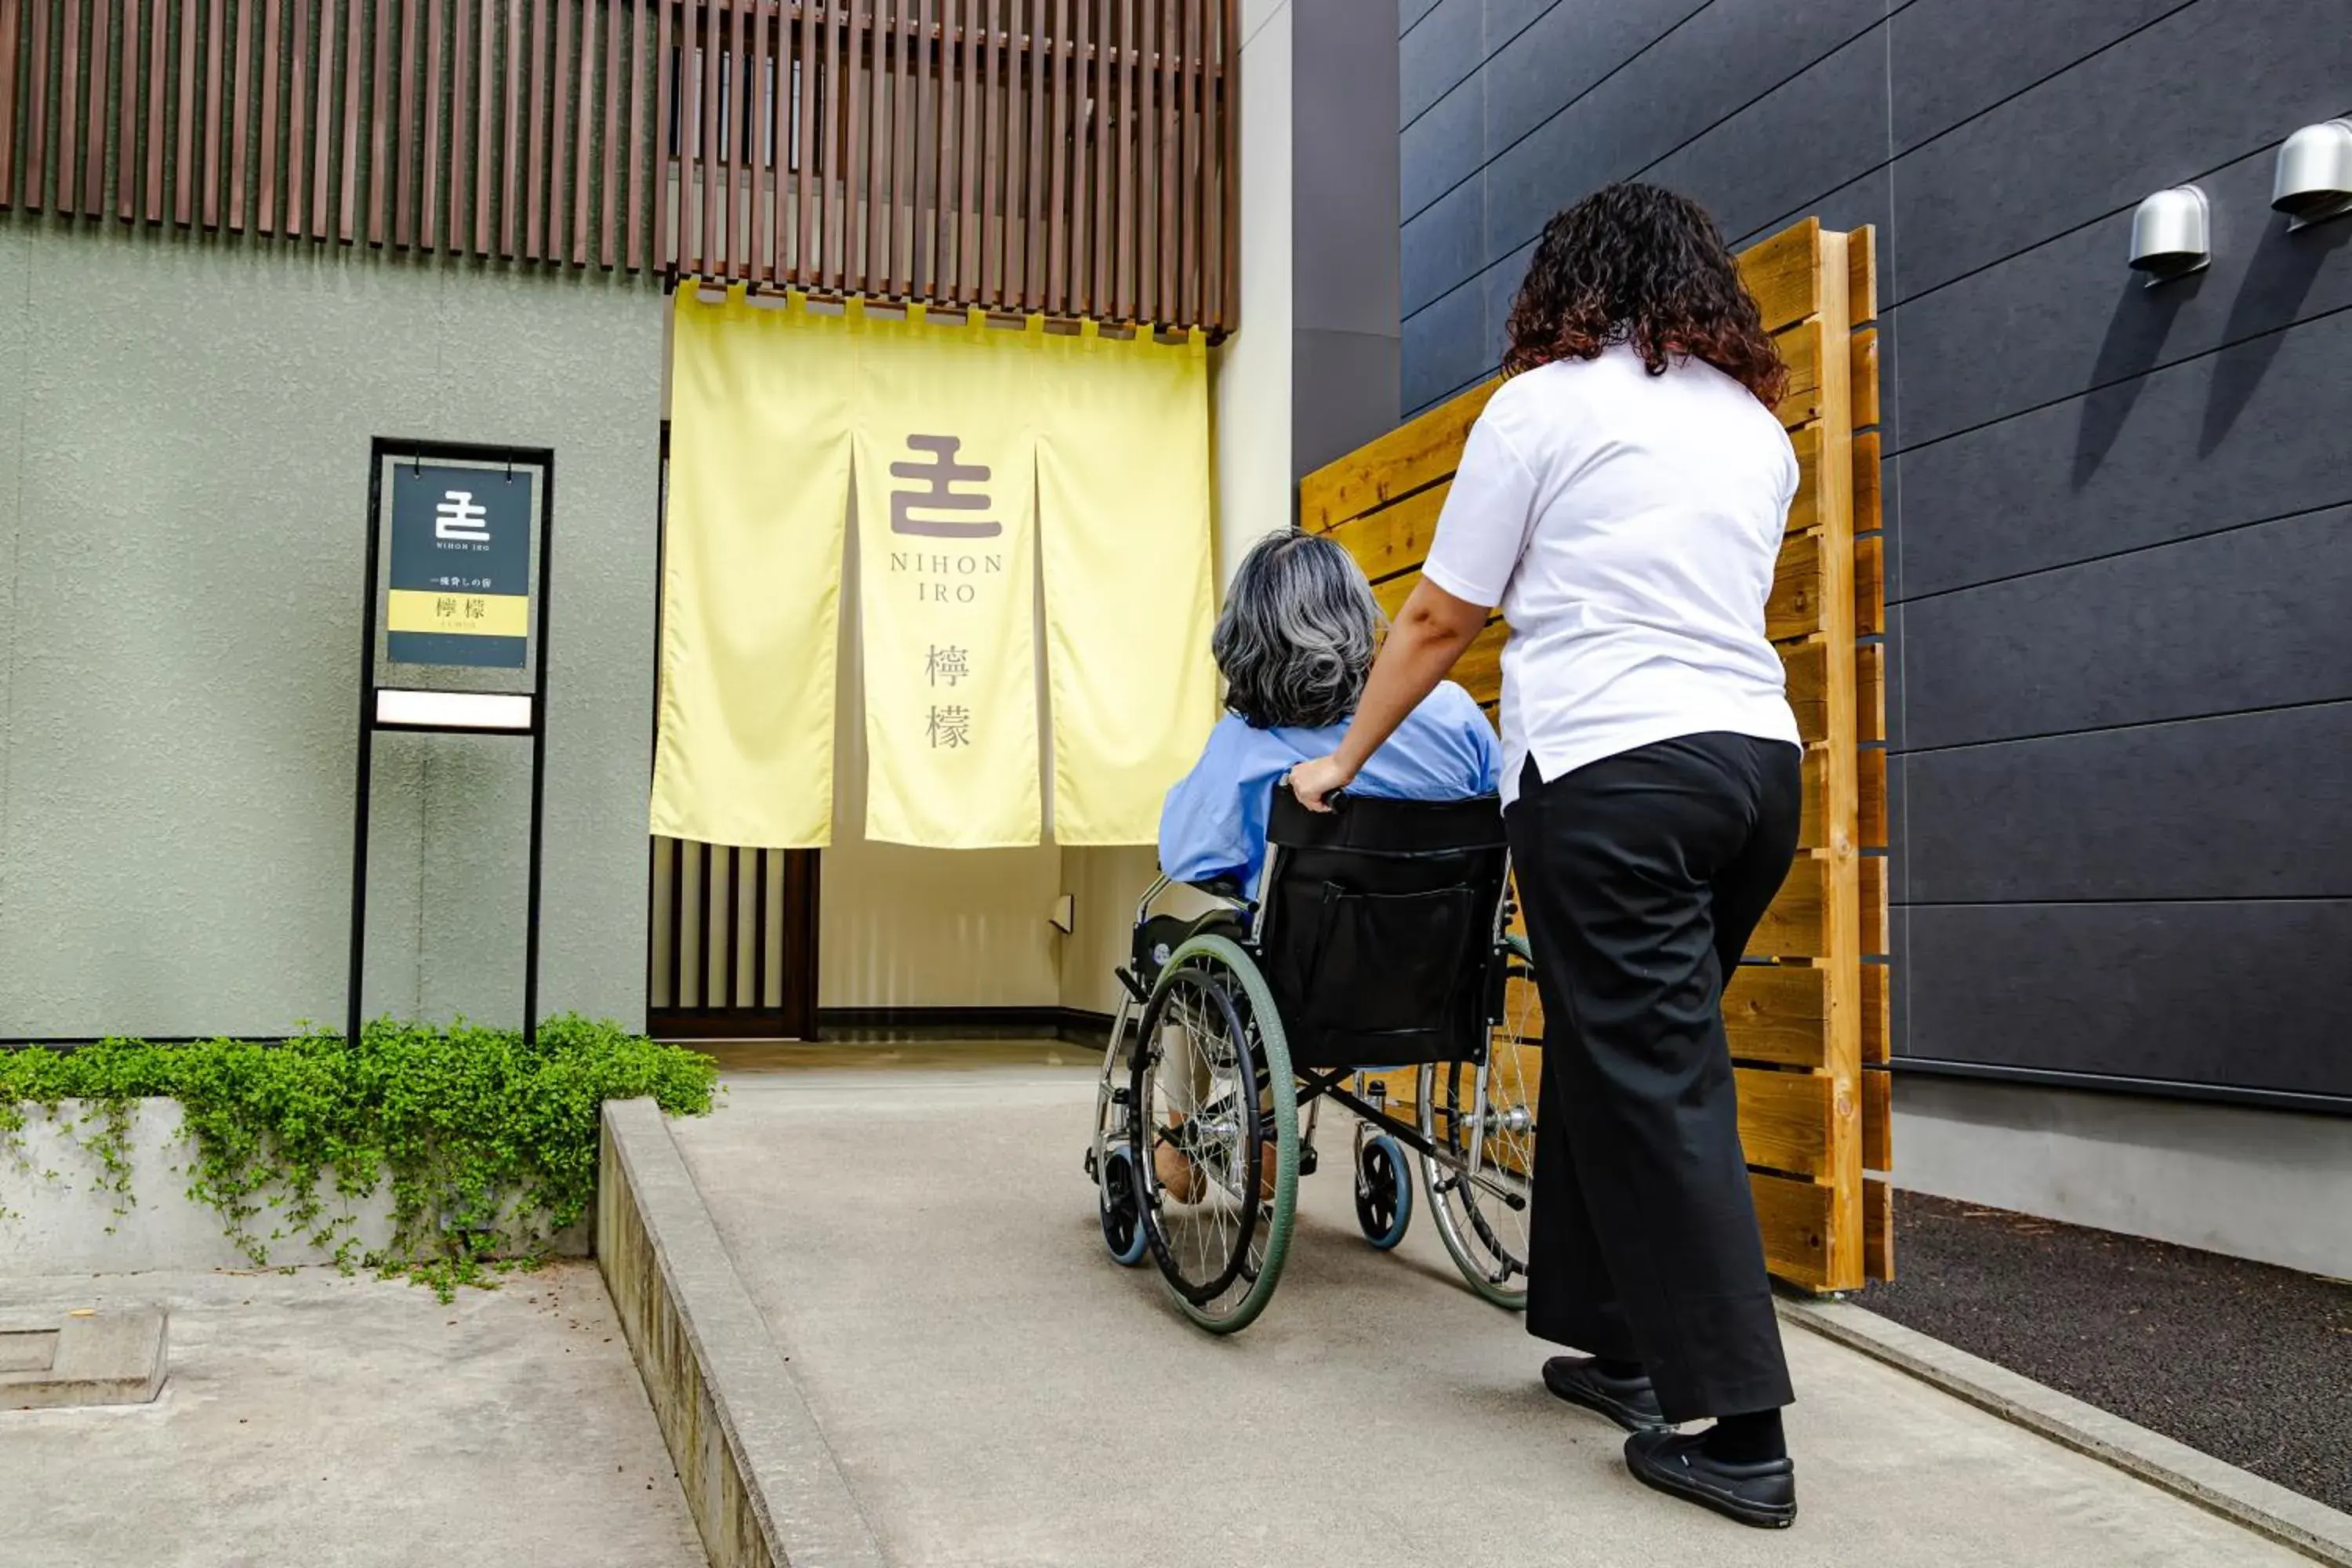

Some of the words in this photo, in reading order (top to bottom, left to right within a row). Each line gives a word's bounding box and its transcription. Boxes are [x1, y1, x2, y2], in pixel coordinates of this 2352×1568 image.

[890, 552, 1002, 574] NIHON
[919, 583, 975, 602] IRO
[925, 644, 970, 748] 檸檬
